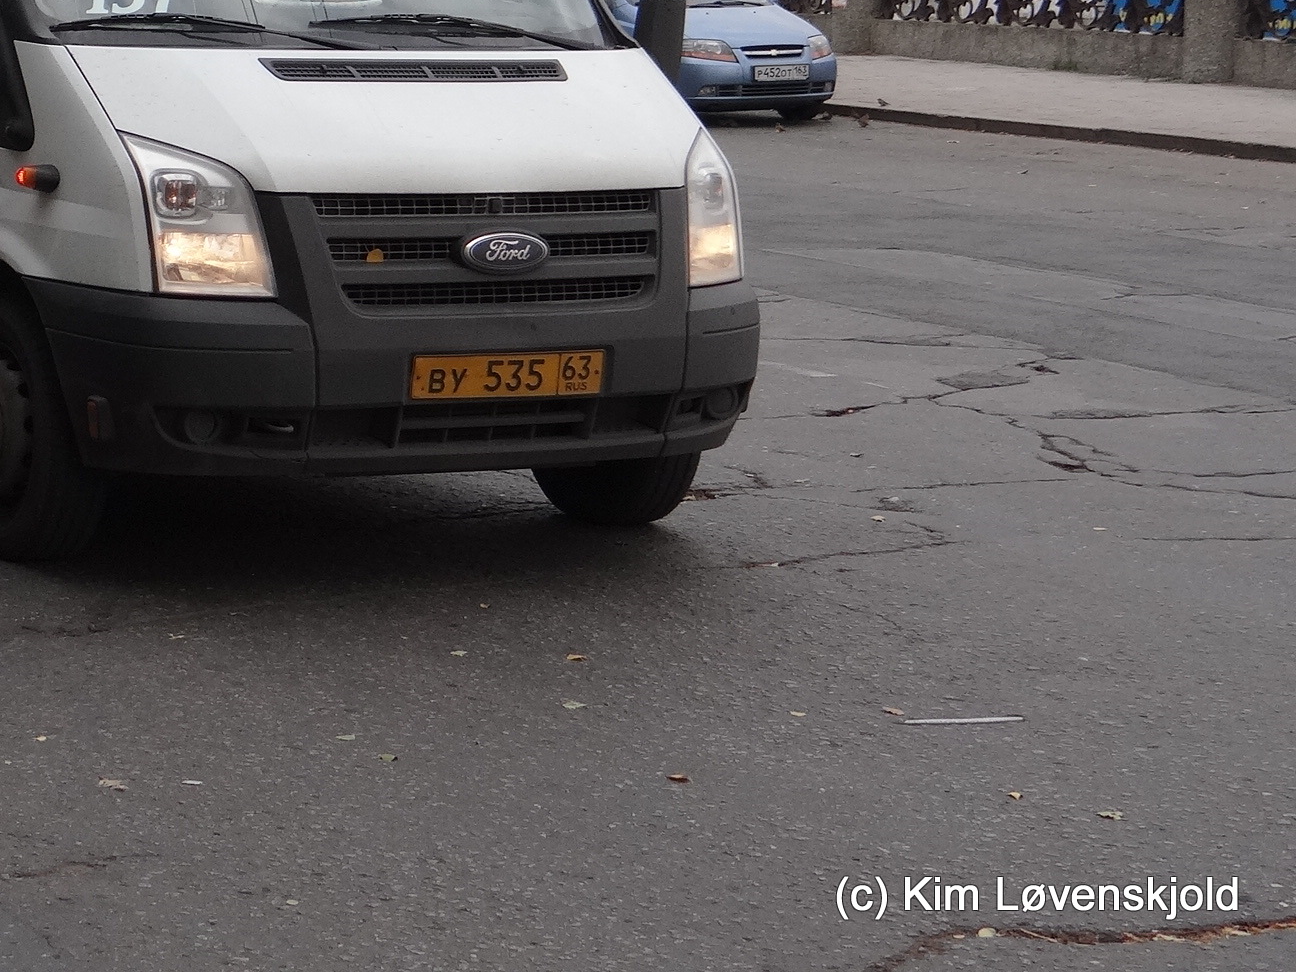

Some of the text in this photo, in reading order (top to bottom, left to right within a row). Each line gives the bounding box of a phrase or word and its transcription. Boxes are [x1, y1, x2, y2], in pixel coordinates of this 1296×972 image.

[485, 239, 531, 262] Ford
[483, 358, 546, 392] 535
[561, 355, 593, 381] 63
[564, 381, 588, 392] RUS
